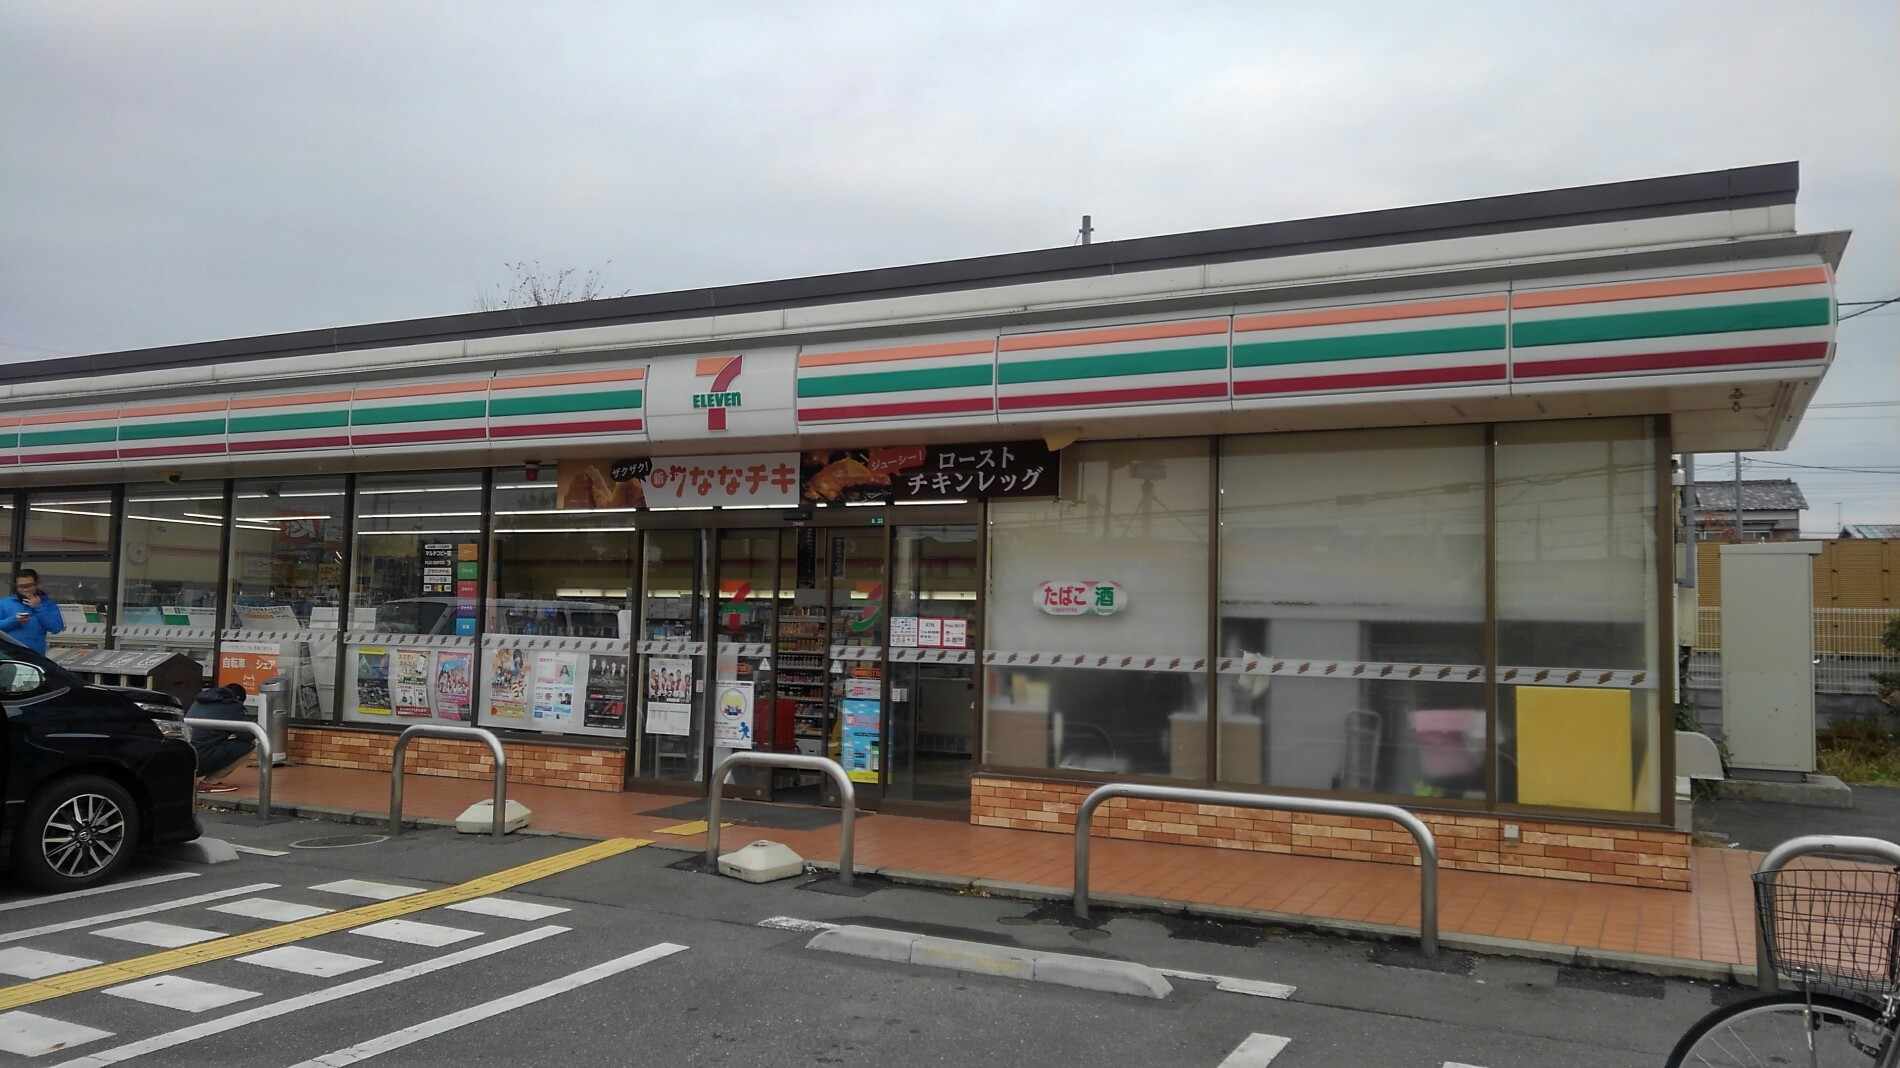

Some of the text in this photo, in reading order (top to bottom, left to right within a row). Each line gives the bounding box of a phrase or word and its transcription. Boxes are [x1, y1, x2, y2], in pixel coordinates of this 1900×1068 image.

[939, 446, 1015, 470] ロースト
[907, 466, 1045, 496] チキンレッグ
[1044, 586, 1115, 606] たばこ 酒
